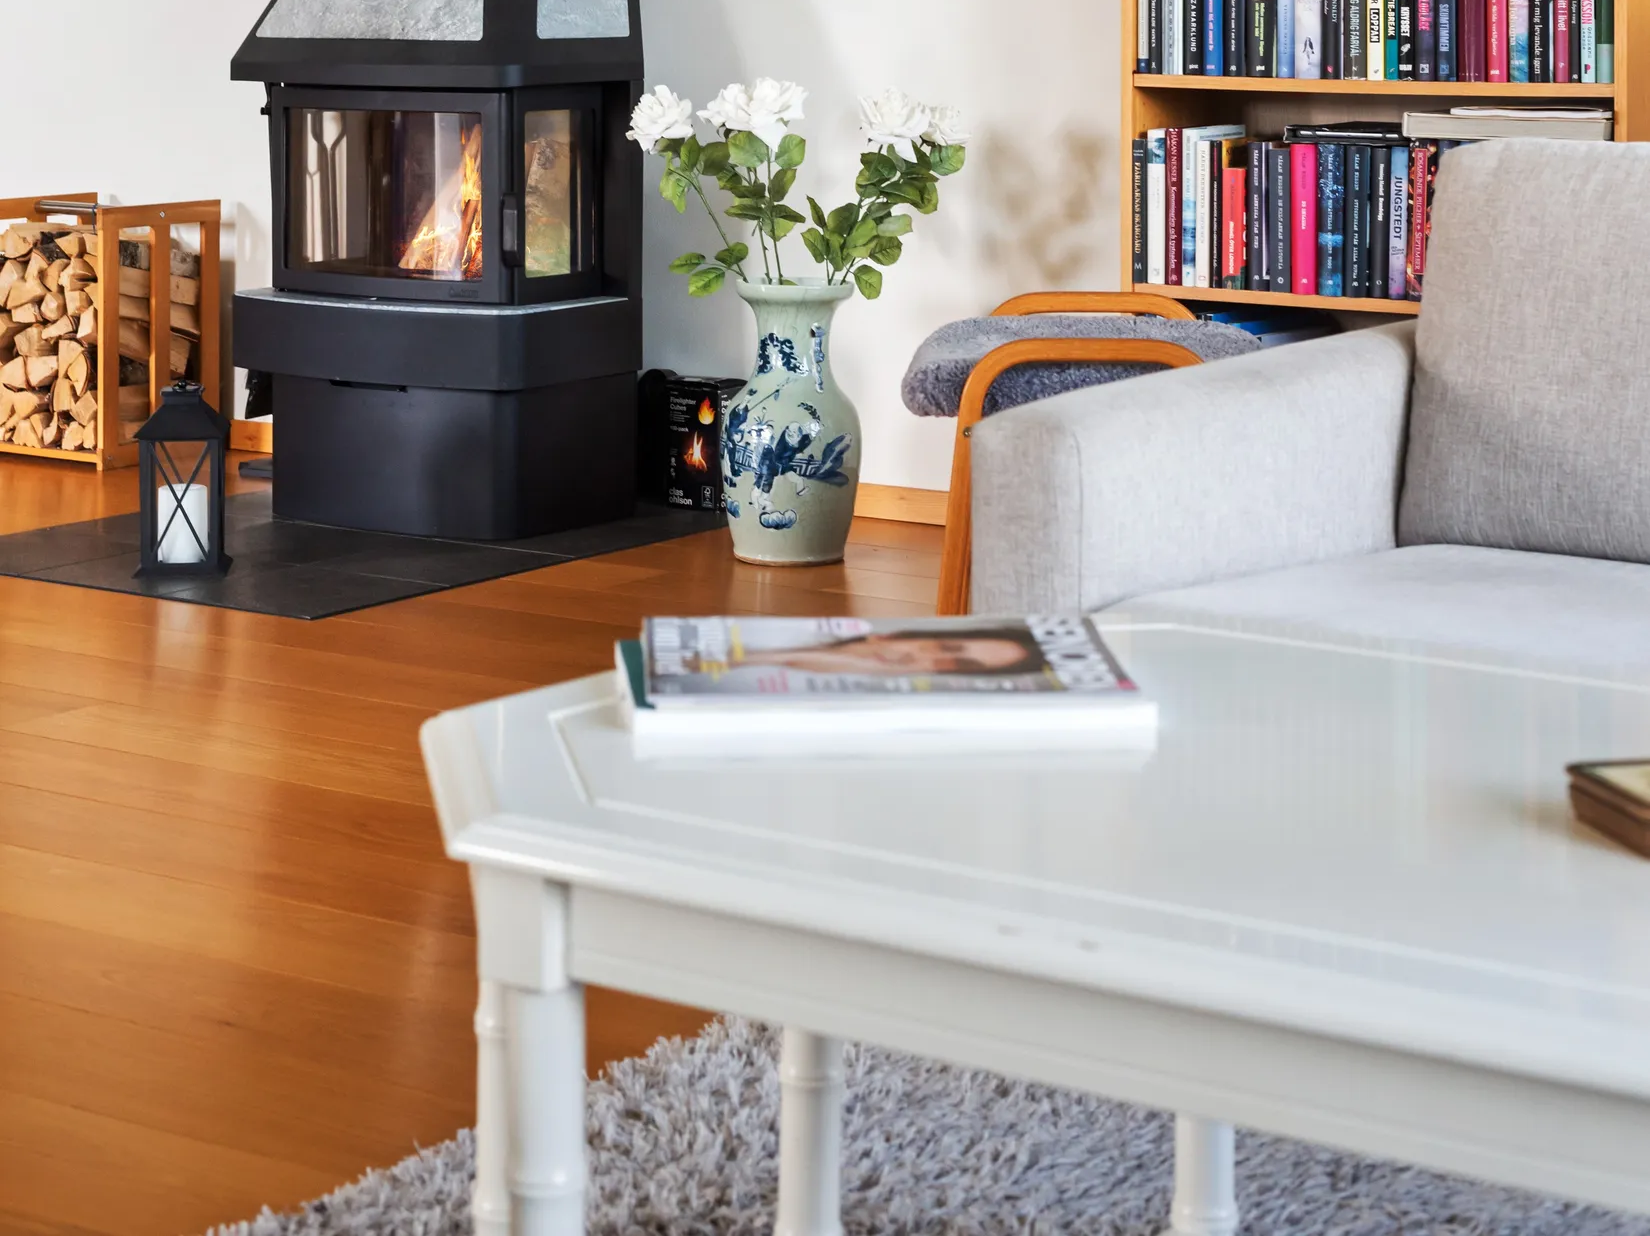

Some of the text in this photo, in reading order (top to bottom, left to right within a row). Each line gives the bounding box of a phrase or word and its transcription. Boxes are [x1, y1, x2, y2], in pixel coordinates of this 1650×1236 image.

[1350, 5, 1359, 30] ALDRIG
[1370, 9, 1379, 42] LOPPAN
[1400, 6, 1410, 37] KRYSSET
[1439, 4, 1449, 52] SKUMTIMMEN
[1508, 7, 1517, 45] Johanna
[1533, 7, 1542, 22] mig
[1558, 15, 1567, 31] livet
[1534, 24, 1542, 55] levande
[1532, 57, 1542, 74] igen
[1134, 162, 1142, 212] FJÄRILARNAS
[1393, 176, 1403, 240] JUNGSTEDT
[1134, 214, 1142, 254] SKÄRGÅRD
[1169, 240, 1177, 268] tystnaden
[670, 396, 696, 405] Firelighter
[669, 487, 684, 496] clas
[669, 495, 692, 506] ohlson
